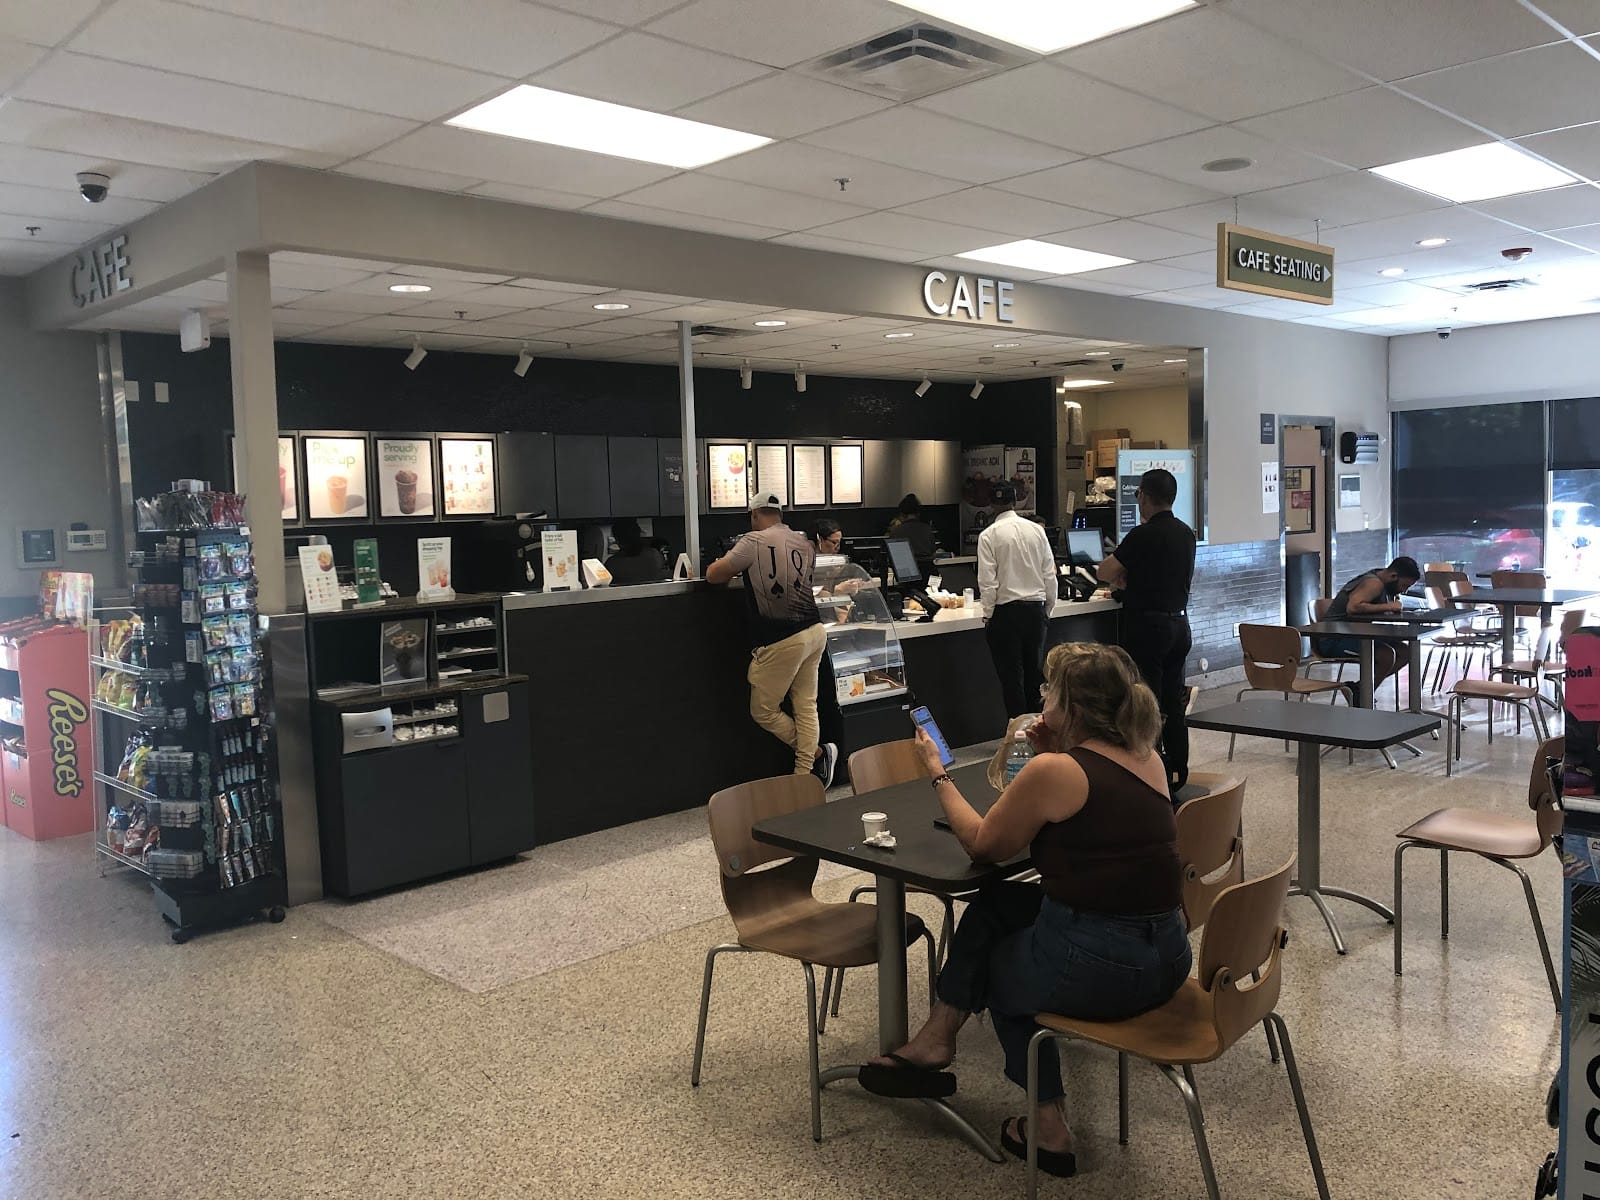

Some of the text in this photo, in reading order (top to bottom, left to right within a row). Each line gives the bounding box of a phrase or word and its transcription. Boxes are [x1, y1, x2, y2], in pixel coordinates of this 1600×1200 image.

[71, 234, 131, 308] CAFE
[1238, 247, 1321, 282] CAFE SEATING
[923, 270, 1015, 322] CAFE
[383, 442, 418, 455] Proudly
[383, 455, 417, 465] serving
[767, 545, 777, 579] J
[791, 549, 803, 577] Q
[47, 689, 88, 797] Reese's
